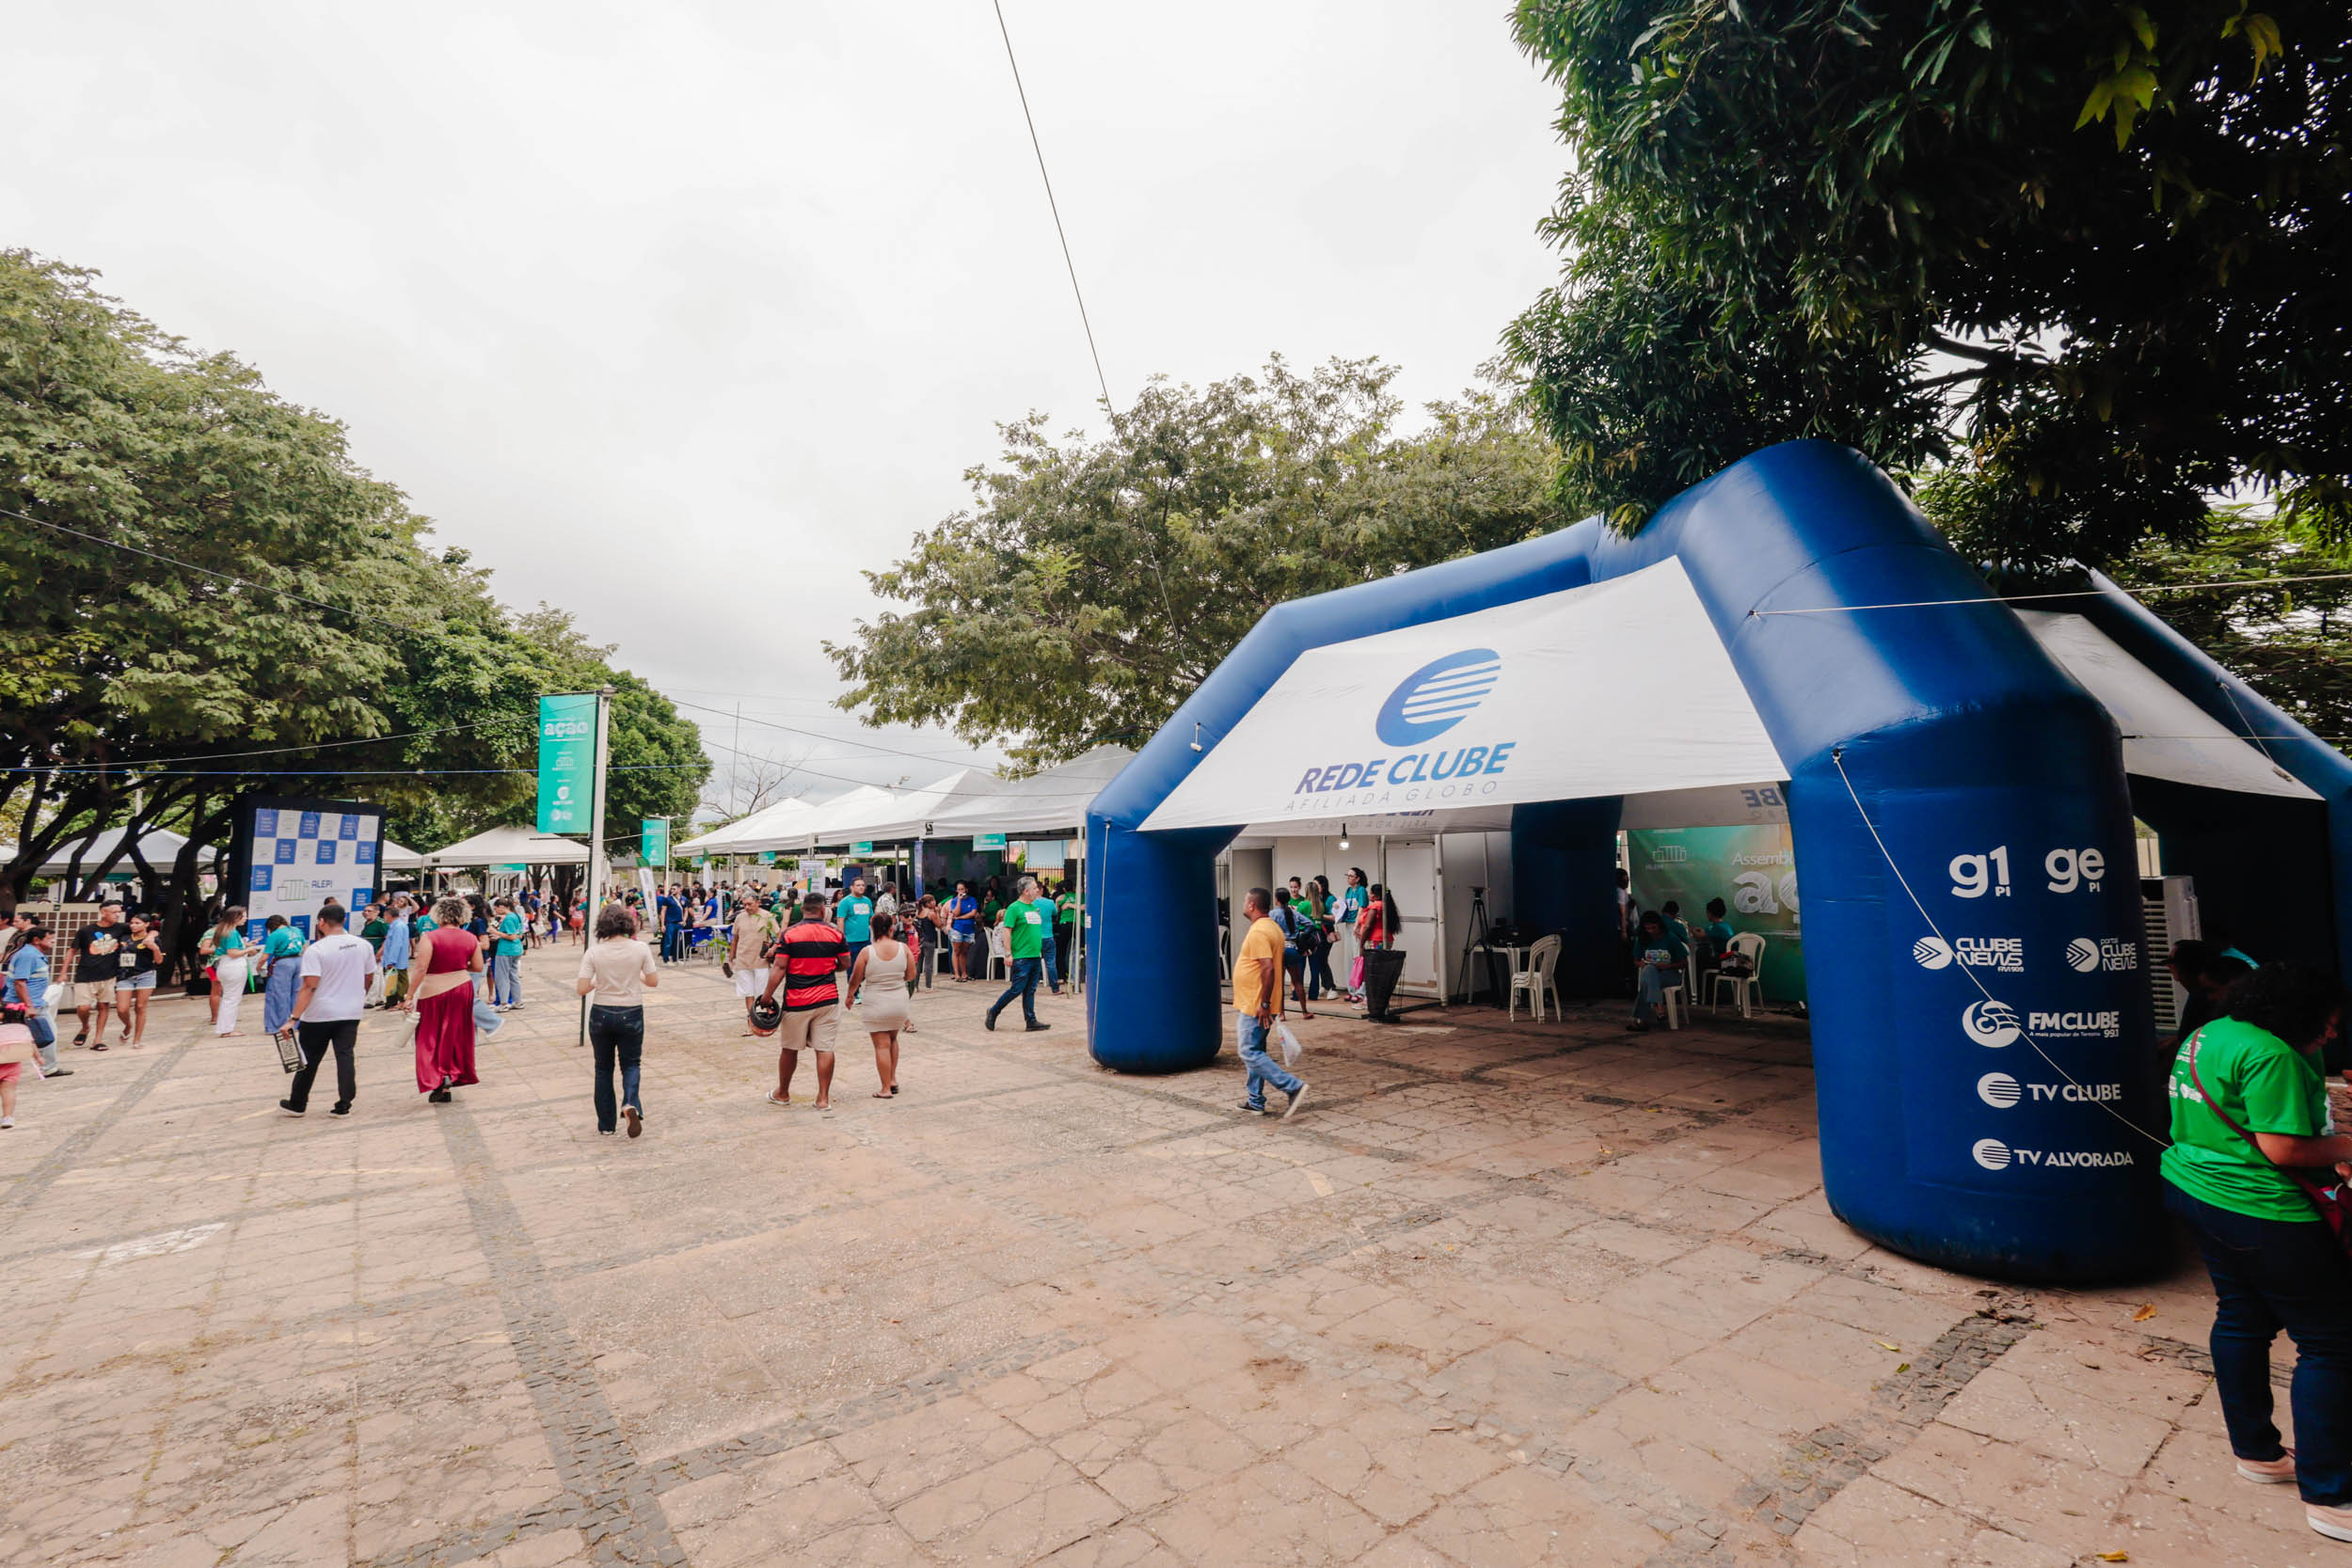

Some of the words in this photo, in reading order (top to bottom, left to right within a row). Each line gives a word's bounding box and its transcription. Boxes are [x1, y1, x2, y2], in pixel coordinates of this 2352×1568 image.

[1295, 759, 1387, 795] REDE
[1387, 741, 1517, 785] CLUBE
[1285, 792, 1391, 812] AFILIADA
[1406, 781, 1498, 801] GLOBO
[1949, 846, 2010, 898] g1
[2044, 847, 2106, 894] ge
[1995, 886, 2011, 897] PI
[2090, 882, 2101, 893] PI
[1955, 938, 2023, 952] CLUBE
[2101, 942, 2137, 958] CLUBE
[1956, 951, 2023, 967] NEWS
[2102, 956, 2137, 971] NEWS
[2026, 1084, 2058, 1101] TV
[2061, 1084, 2122, 1101] CLUBE
[2013, 1148, 2042, 1165] TV
[2044, 1151, 2135, 1167] ALVORADA
